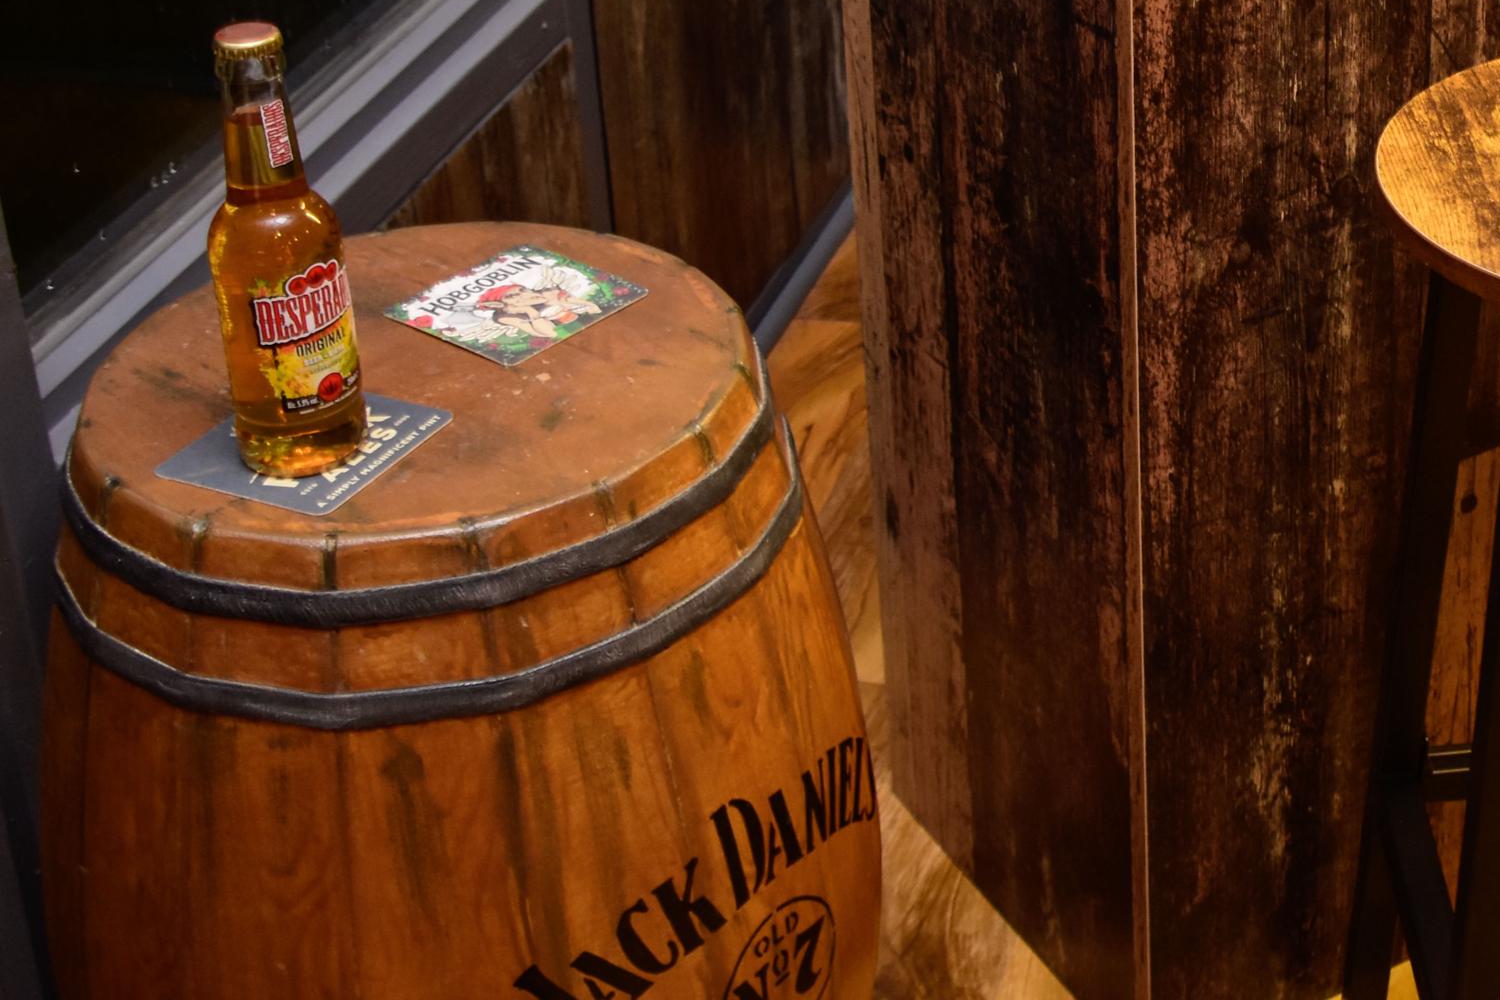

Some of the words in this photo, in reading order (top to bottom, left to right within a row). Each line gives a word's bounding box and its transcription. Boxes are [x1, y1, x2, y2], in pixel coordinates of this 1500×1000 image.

[420, 255, 541, 317] HOBGOBLIN
[326, 475, 361, 501] SIMPLY
[359, 430, 420, 476] MAGNIFICENT
[418, 414, 442, 431] PINT
[754, 910, 800, 959] OLD
